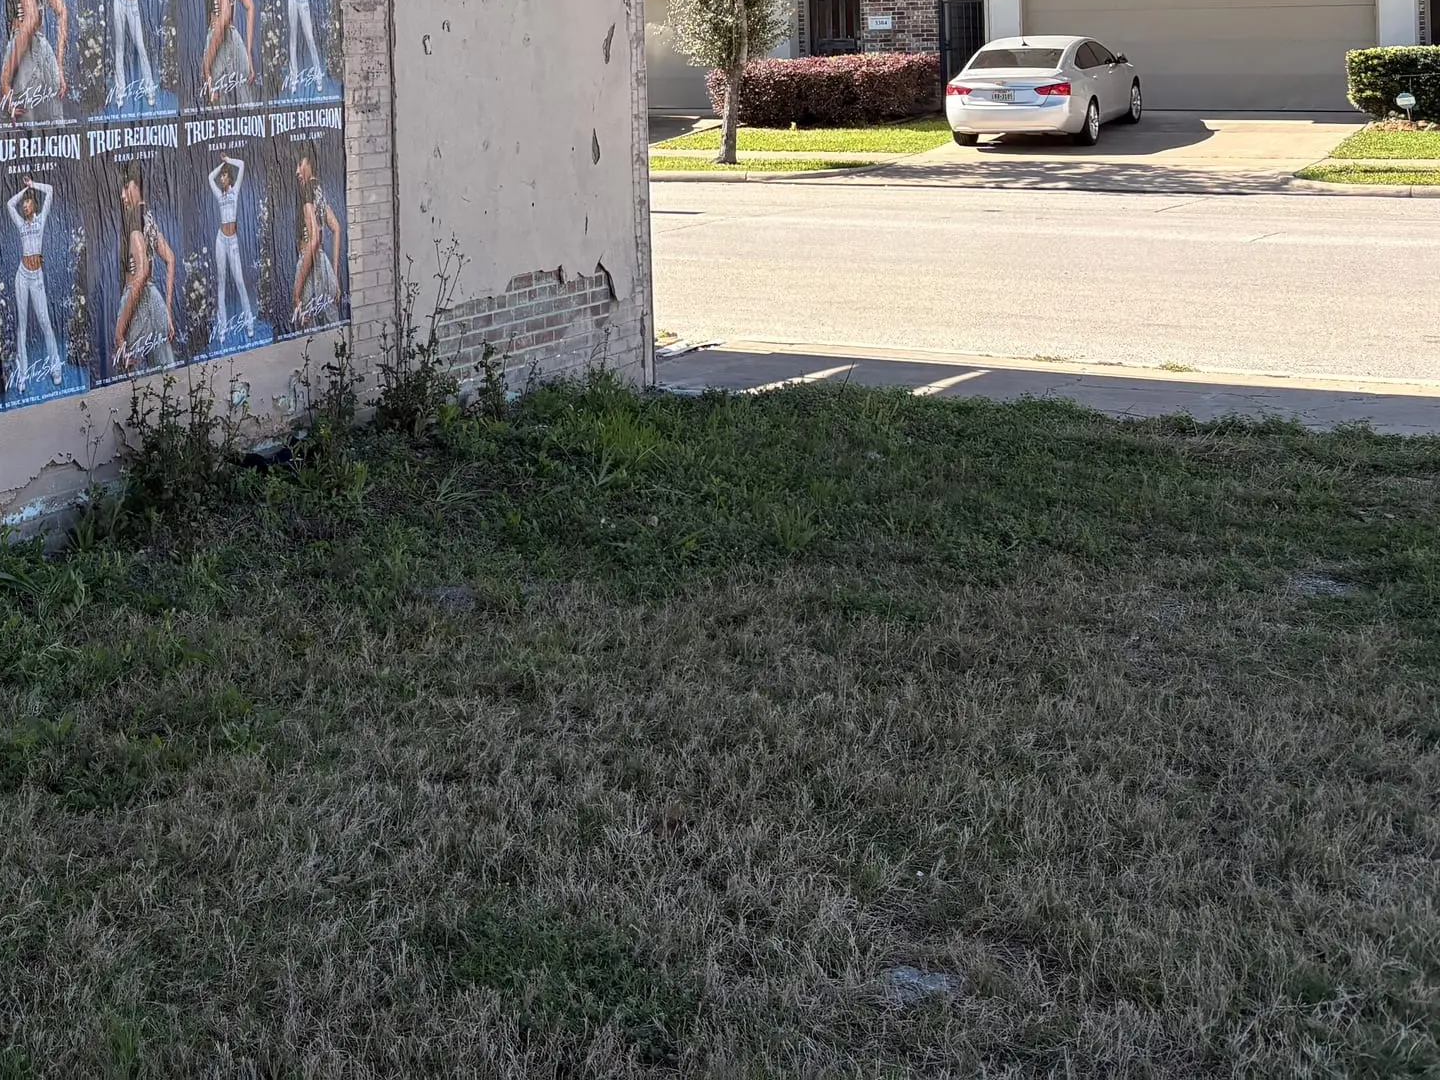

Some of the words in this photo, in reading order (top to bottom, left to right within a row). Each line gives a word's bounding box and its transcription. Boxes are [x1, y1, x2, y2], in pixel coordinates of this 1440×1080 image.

[185, 120, 214, 145] TRUE
[217, 115, 264, 137] RELIGION
[268, 112, 295, 136] TRUE
[298, 107, 340, 128] RELIGION
[20, 134, 79, 159] RELIGION
[87, 129, 120, 156] TRUE
[124, 124, 176, 147] RELIGION
